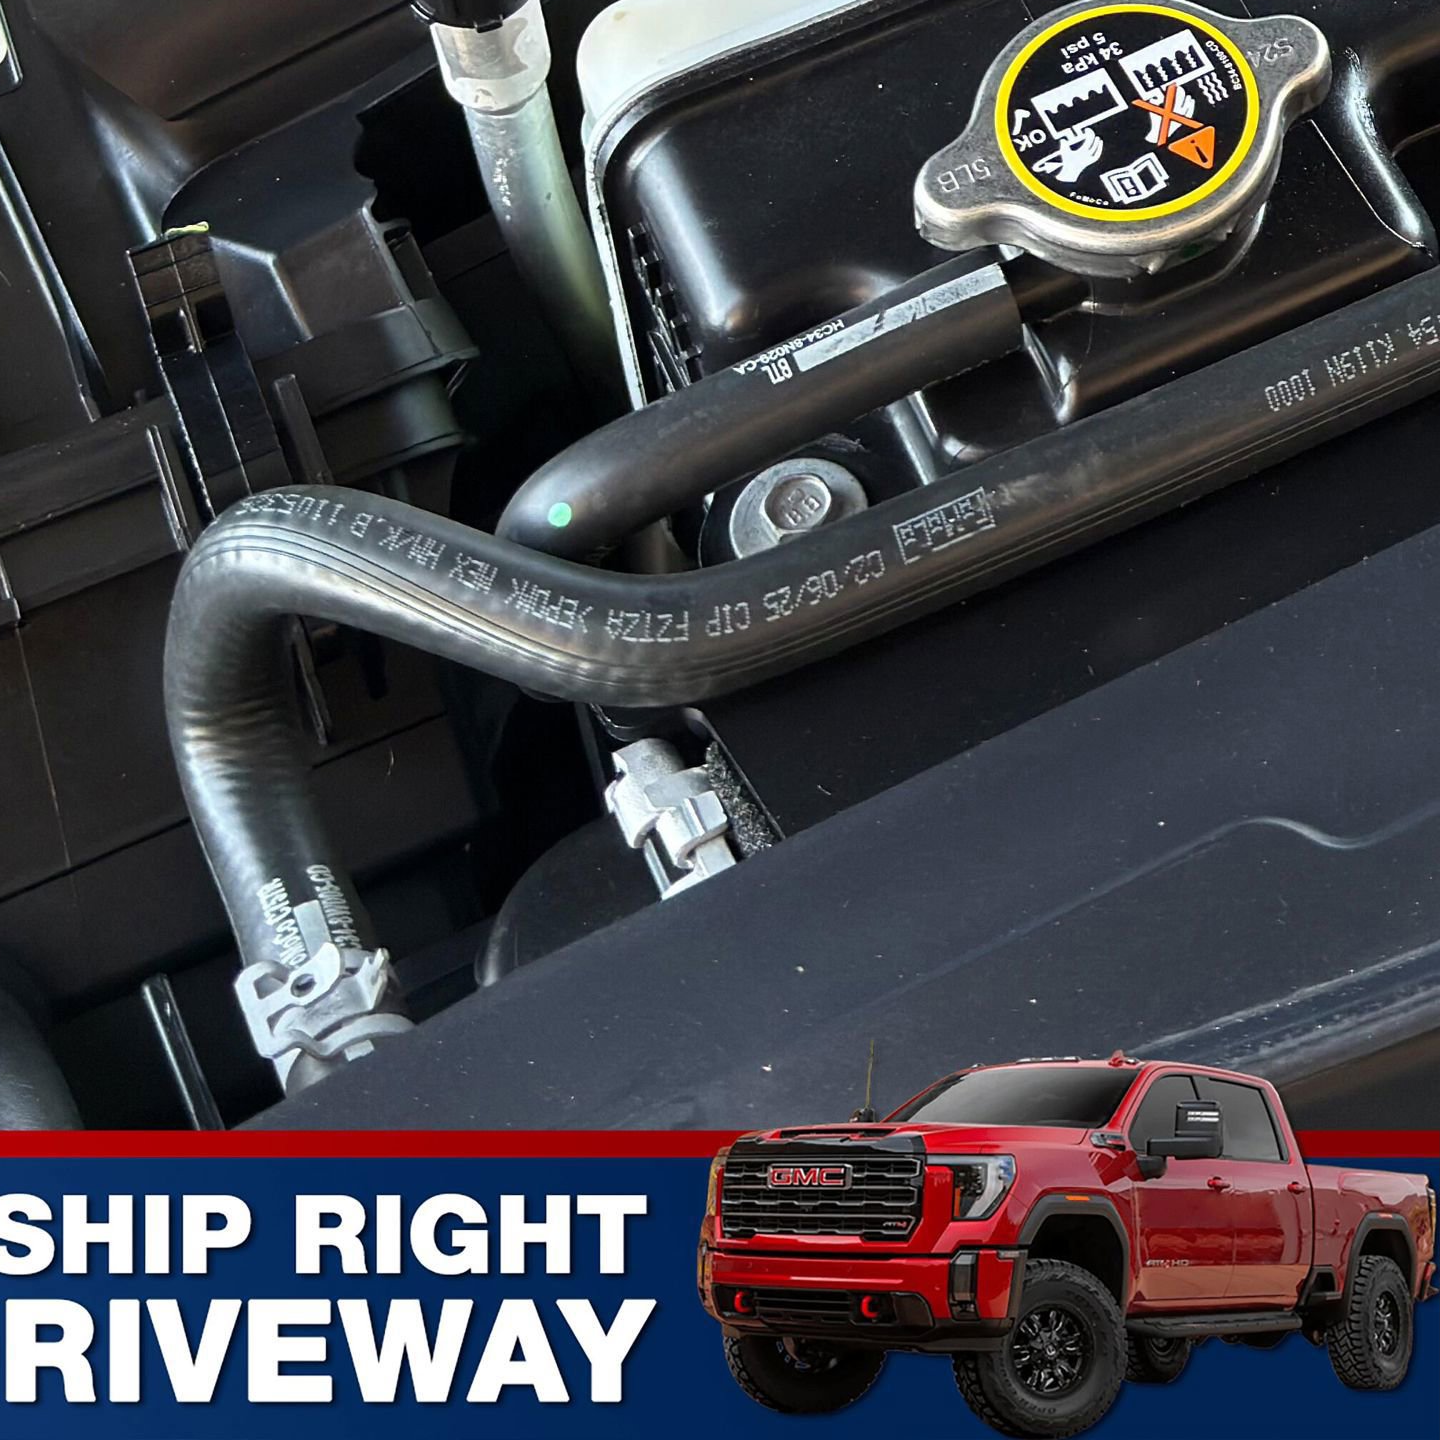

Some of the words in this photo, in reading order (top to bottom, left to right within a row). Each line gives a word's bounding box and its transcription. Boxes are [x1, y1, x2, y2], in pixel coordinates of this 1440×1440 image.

[1061, 36, 1092, 60] psi
[1093, 32, 1107, 45] 5
[1099, 41, 1124, 61] 34
[1061, 53, 1101, 74] kPa
[1012, 128, 1048, 153] OK
[938, 157, 993, 193] 5LB
[1263, 368, 1316, 412] 1000
